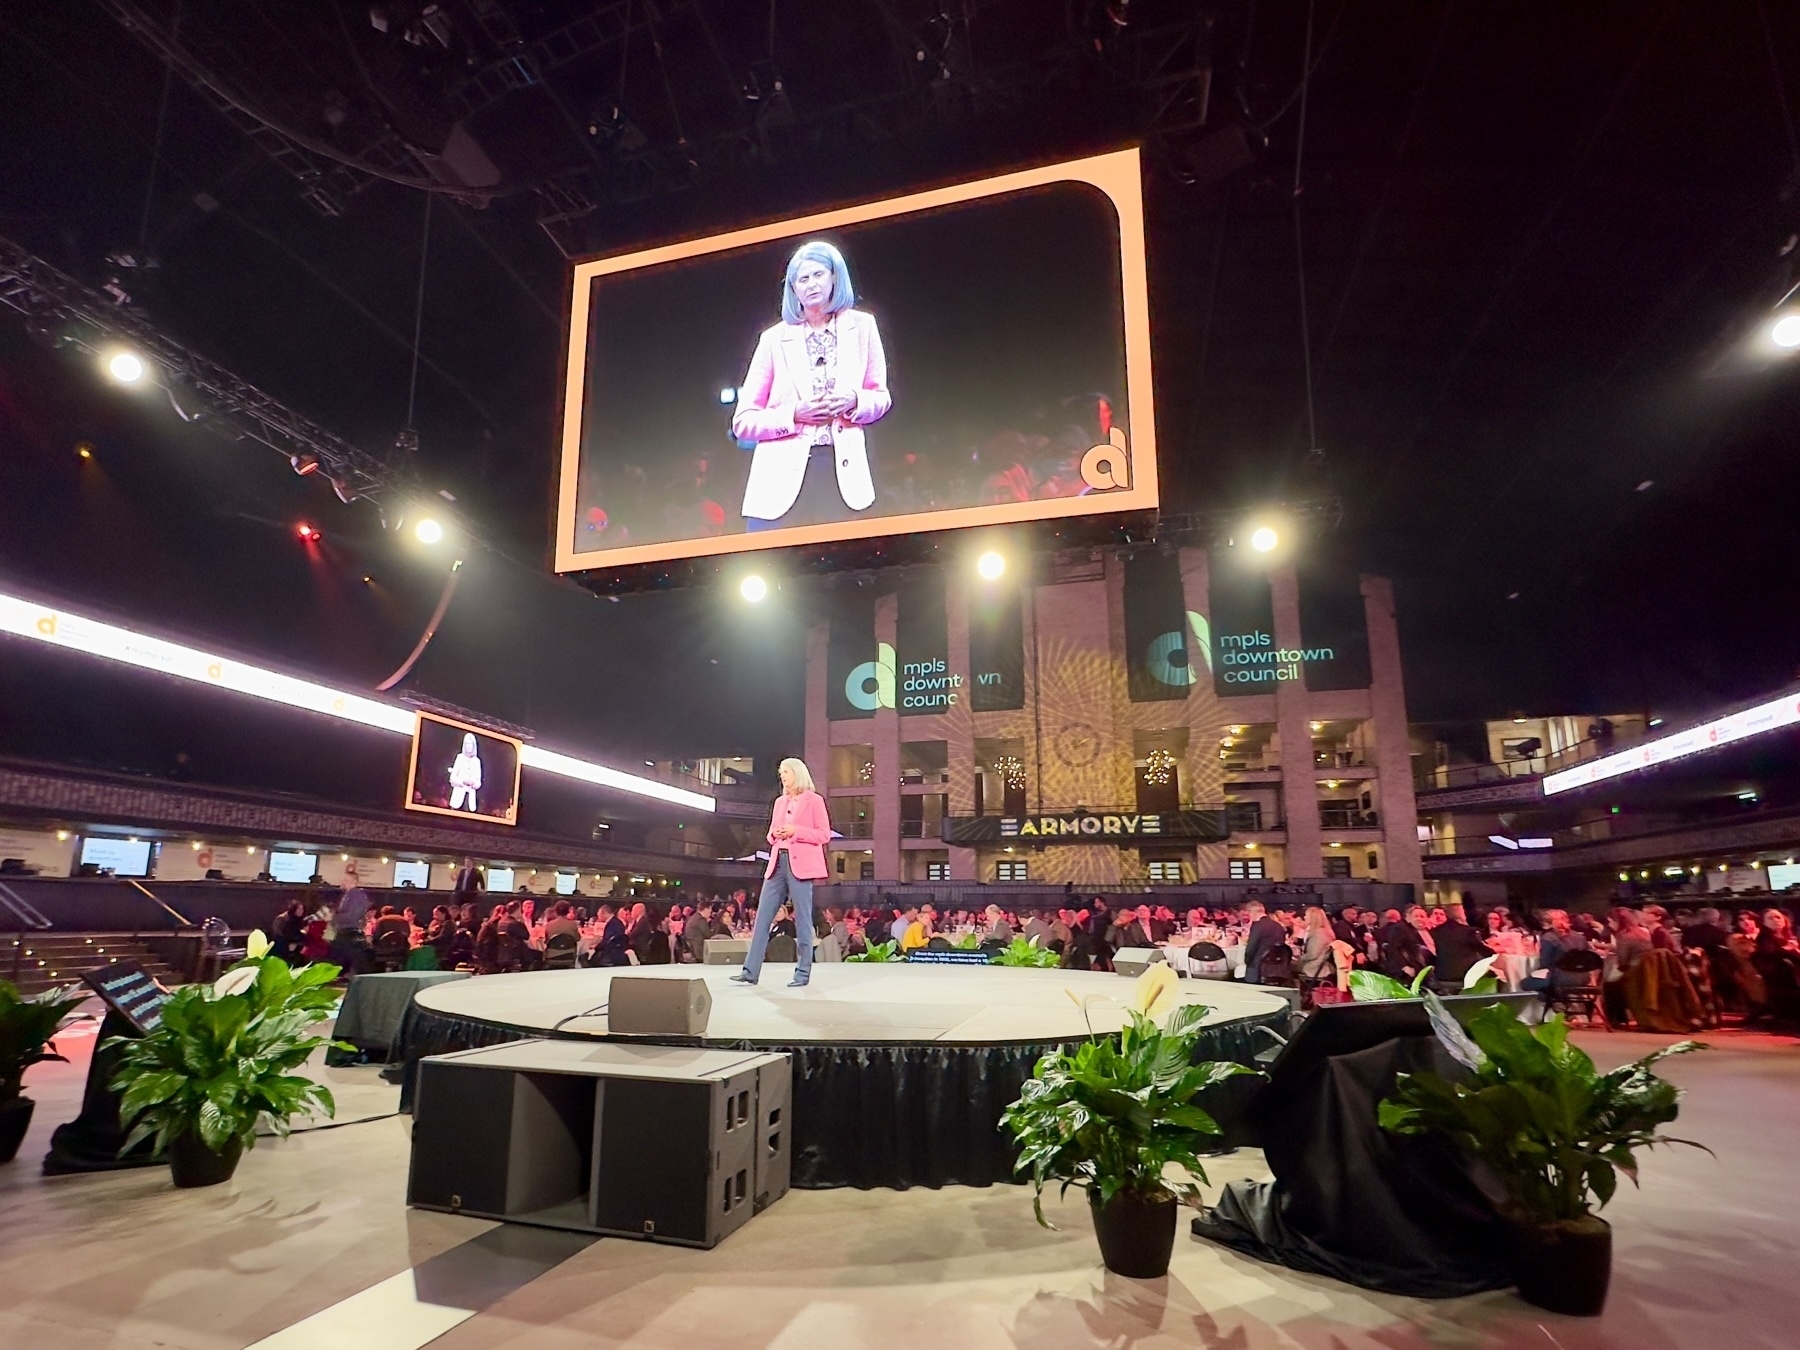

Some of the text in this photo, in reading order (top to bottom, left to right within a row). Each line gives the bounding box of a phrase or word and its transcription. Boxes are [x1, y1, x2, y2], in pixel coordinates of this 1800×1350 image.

[1220, 630, 1271, 649] mpls
[1222, 648, 1334, 665] downtown
[904, 657, 946, 677] mpls
[1224, 664, 1298, 683] council
[903, 673, 1001, 692] downtwn
[1020, 815, 1140, 836] ARMORY
